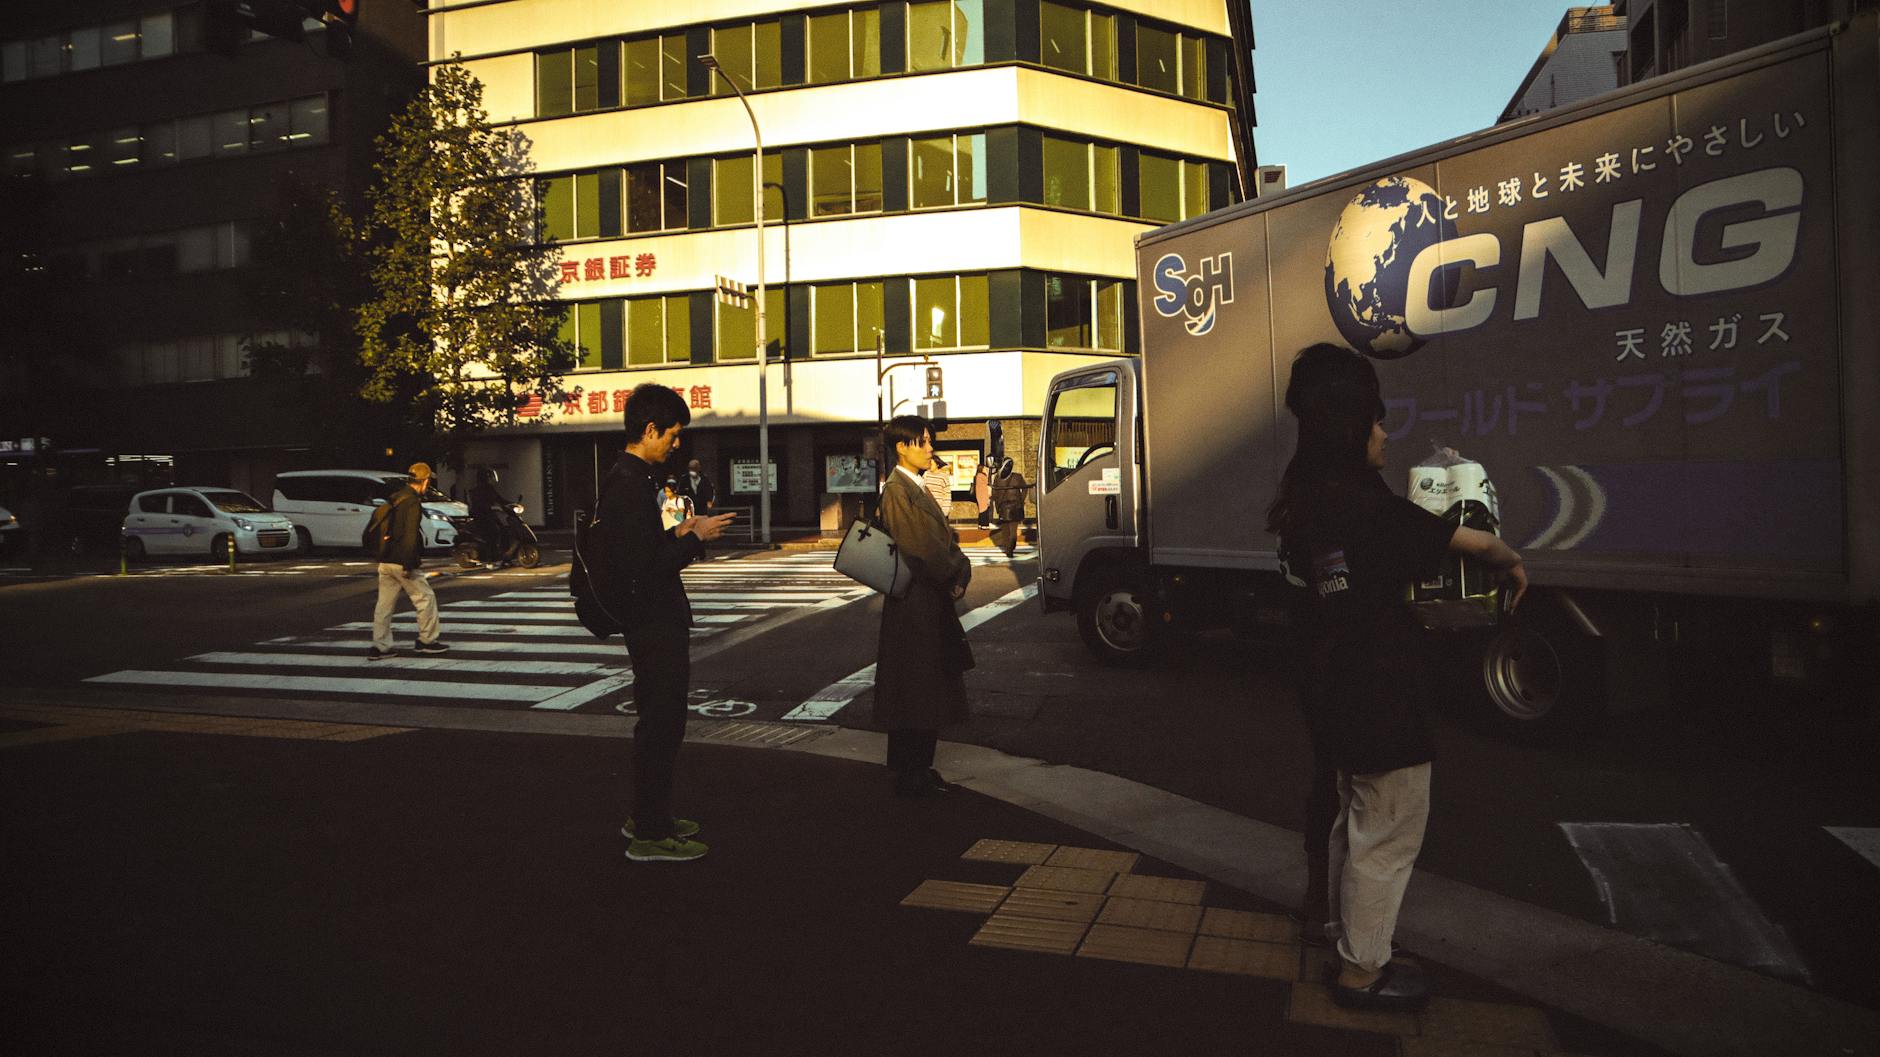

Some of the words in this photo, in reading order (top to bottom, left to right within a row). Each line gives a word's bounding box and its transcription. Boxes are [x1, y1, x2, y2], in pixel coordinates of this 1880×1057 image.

[1415, 110, 1806, 228] 人と地球と未来にやさしい
[560, 253, 657, 284] 京銀証券
[1404, 166, 1805, 337] CNG
[1615, 311, 1790, 362] 天然ガス
